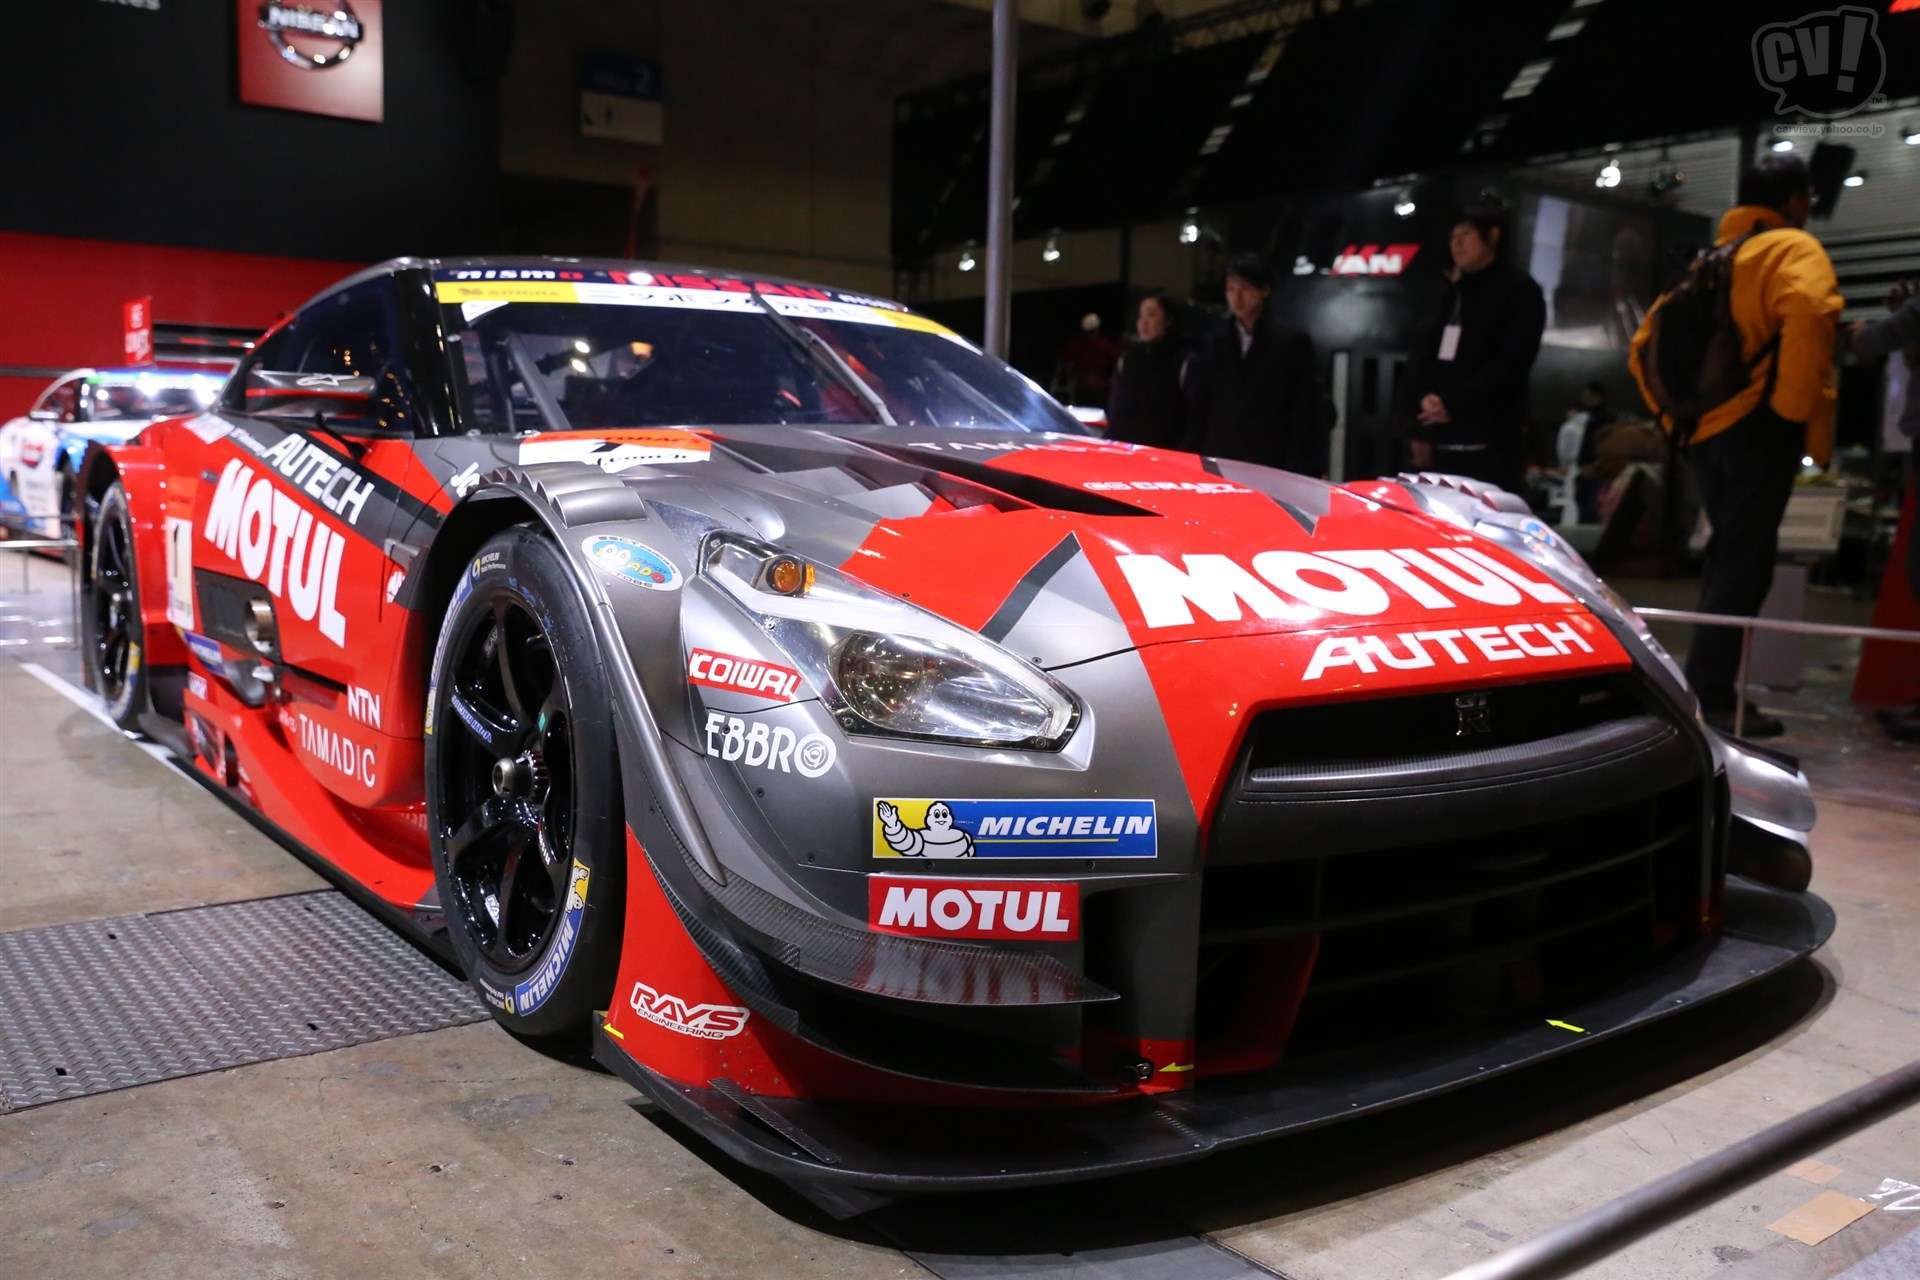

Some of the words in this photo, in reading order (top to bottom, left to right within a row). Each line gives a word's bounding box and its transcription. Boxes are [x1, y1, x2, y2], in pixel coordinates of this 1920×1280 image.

[262, 432, 376, 525] AUTECH
[204, 458, 347, 648] MOTUL
[1115, 546, 1577, 629] MOTUL
[1302, 621, 1595, 680] AUTECH
[347, 684, 381, 729] NTN
[299, 713, 377, 788] TAMADIC
[705, 712, 837, 778] EBBRO
[977, 815, 1153, 836] MICHELIN
[877, 889, 1071, 932] MOTUL
[519, 918, 575, 1011] MICHELIN
[632, 987, 746, 1032] RAYS
[637, 1008, 725, 1038] ENGINEERING
